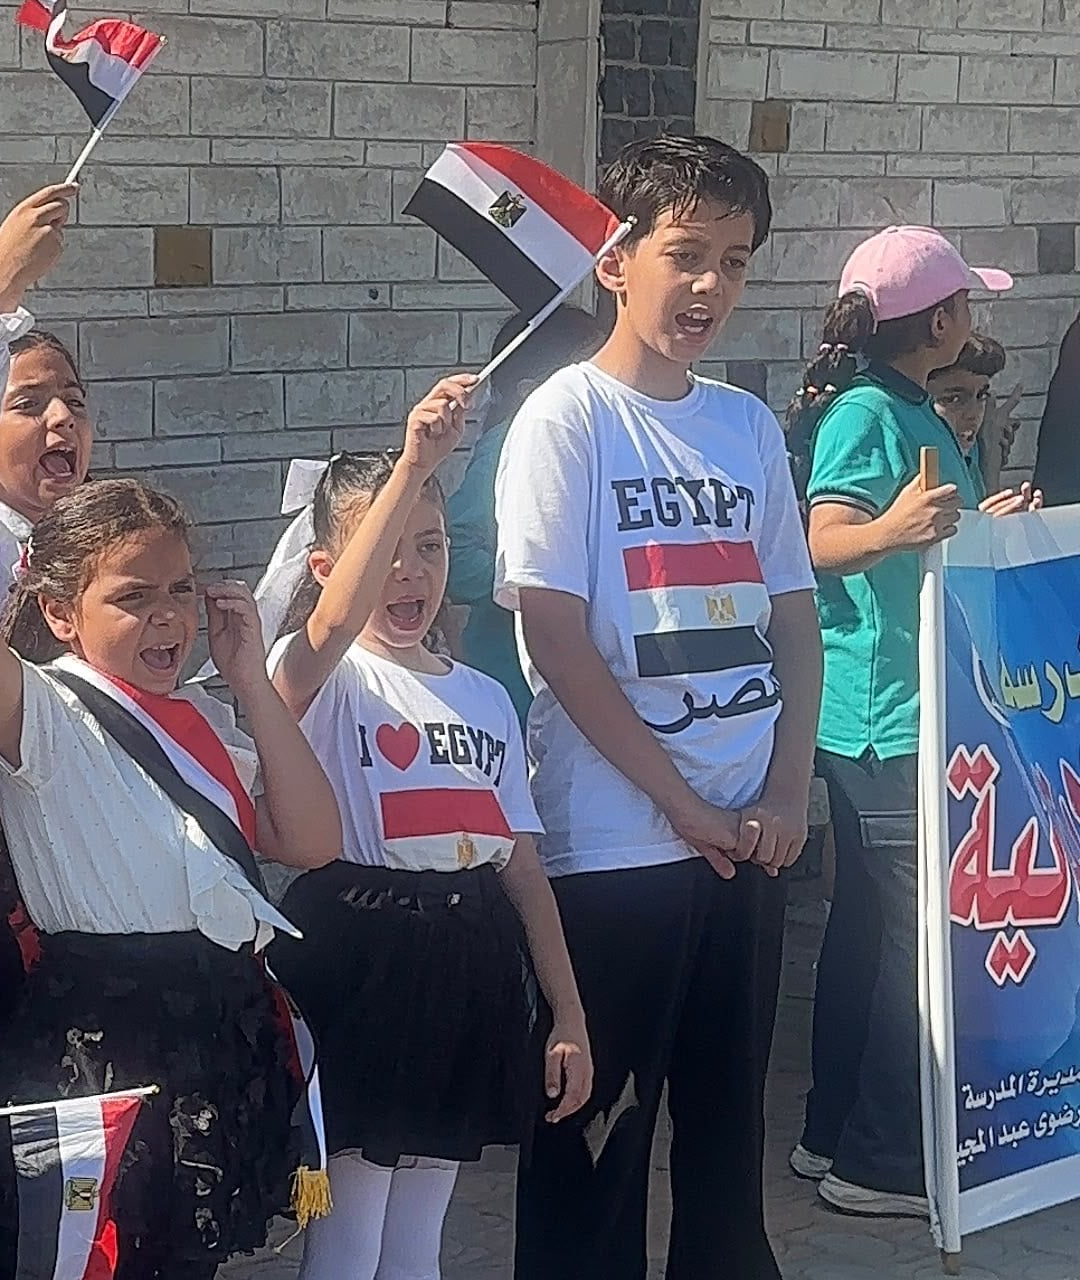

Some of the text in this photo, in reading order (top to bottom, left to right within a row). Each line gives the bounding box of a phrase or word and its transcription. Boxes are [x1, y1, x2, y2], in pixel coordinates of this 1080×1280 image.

[610, 477, 756, 532] EGYPT
[642, 677, 783, 734] مصر
[358, 722, 506, 787] I EGYPT
[961, 1073, 1024, 1111] المدرسة
[957, 1126, 994, 1167] المجي
